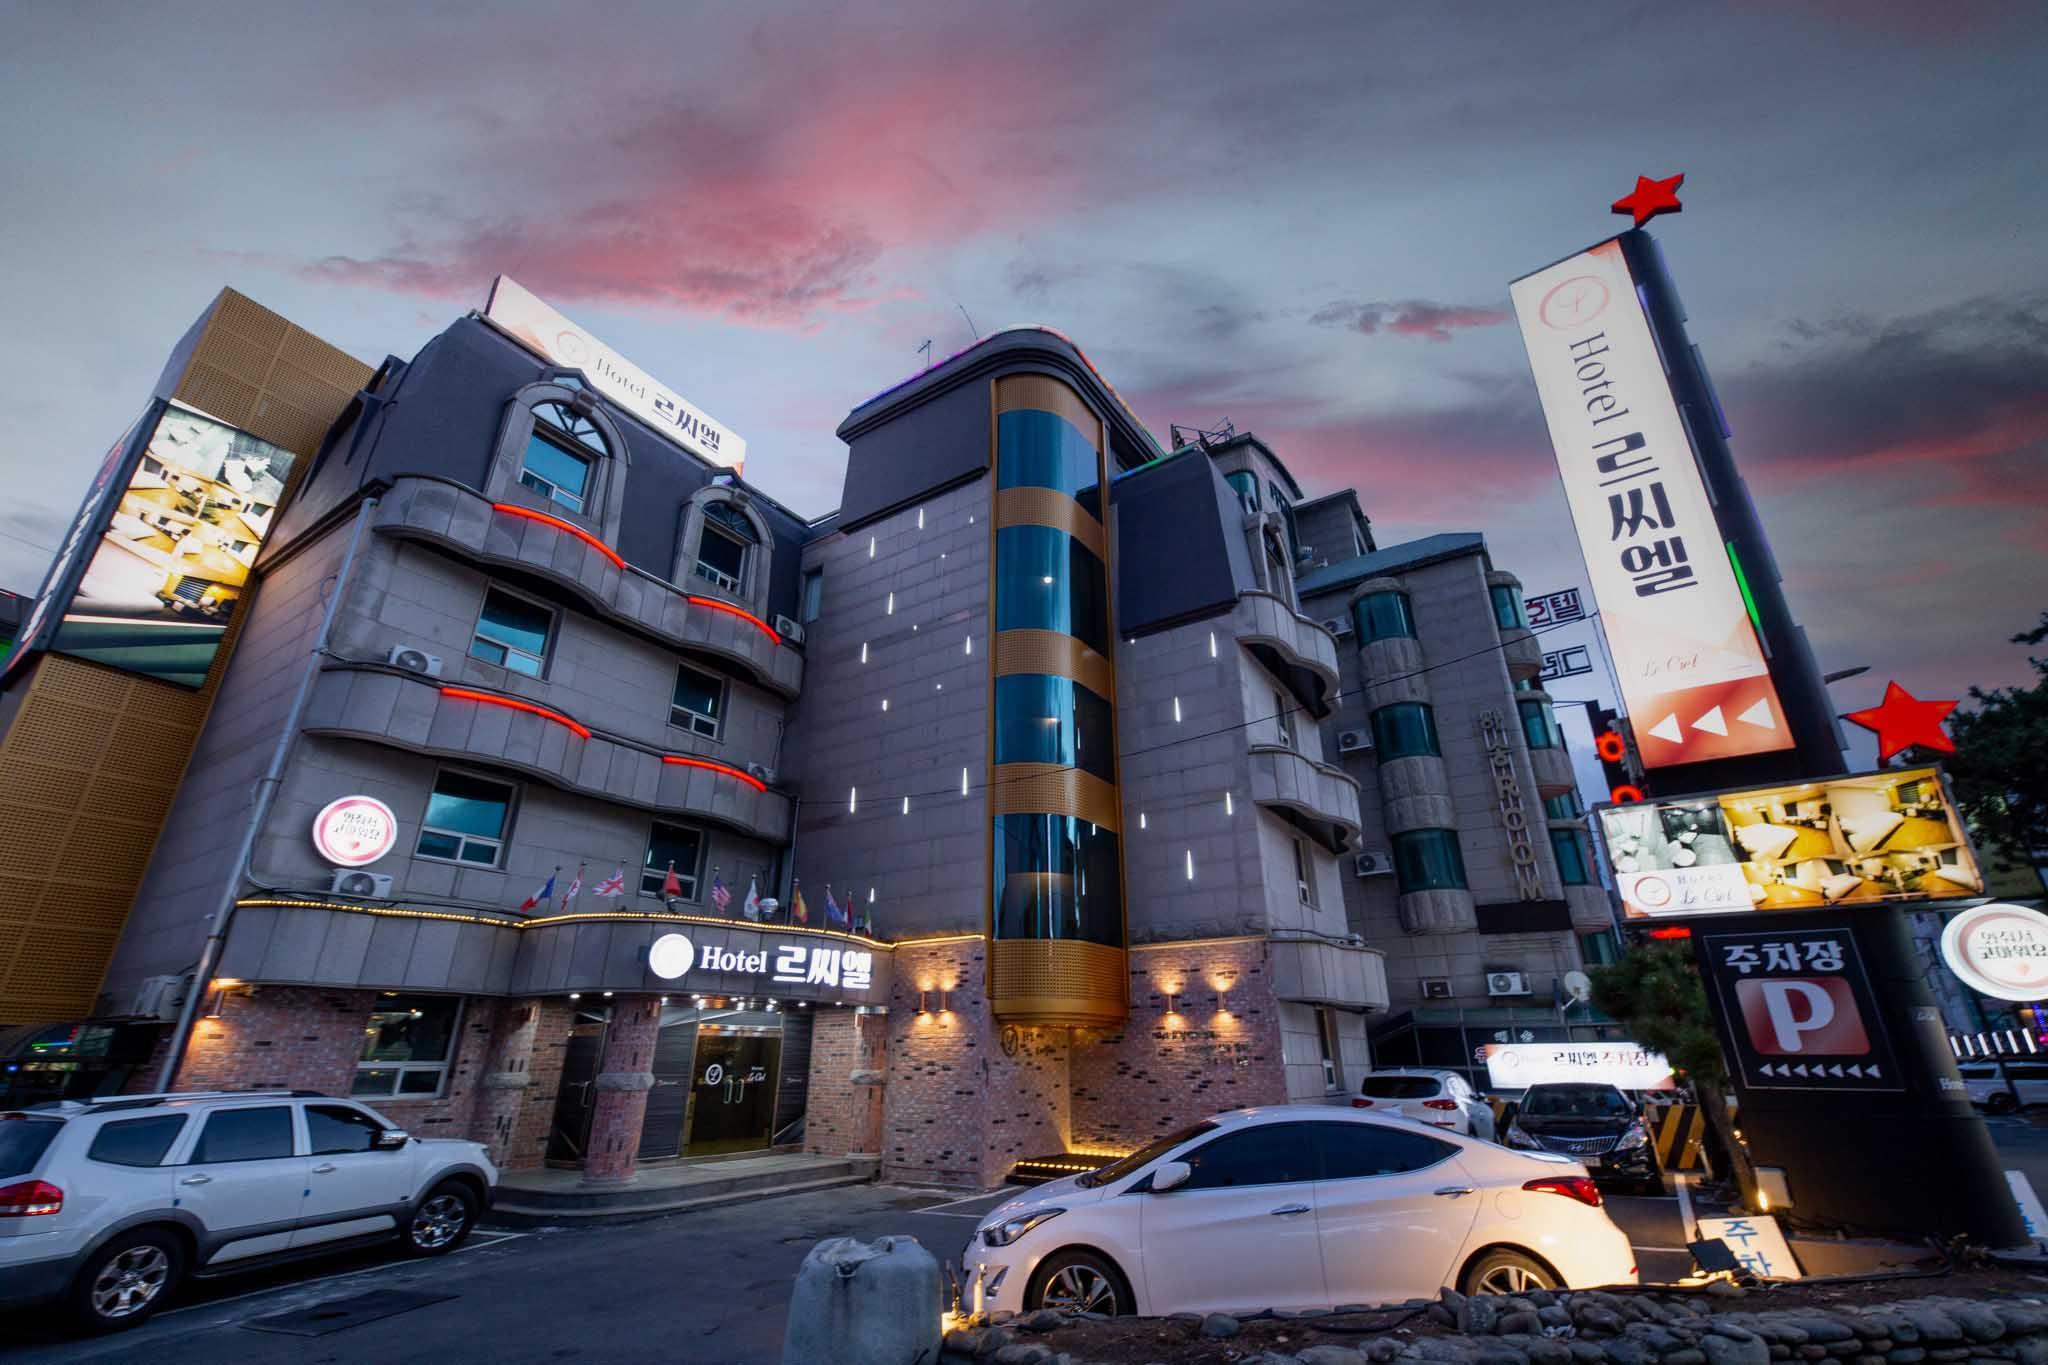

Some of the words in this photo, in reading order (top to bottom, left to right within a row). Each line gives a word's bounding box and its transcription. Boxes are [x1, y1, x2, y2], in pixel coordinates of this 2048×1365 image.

[597, 358, 645, 399] Hotel
[652, 393, 721, 454] 르씨엘
[1569, 331, 1629, 427] Hotel
[1591, 431, 1698, 597] 르씨엘
[700, 945, 768, 973] Hotel
[773, 945, 872, 989] 르씨엘
[1723, 940, 1845, 974] 주차장
[1761, 980, 1836, 1052] P
